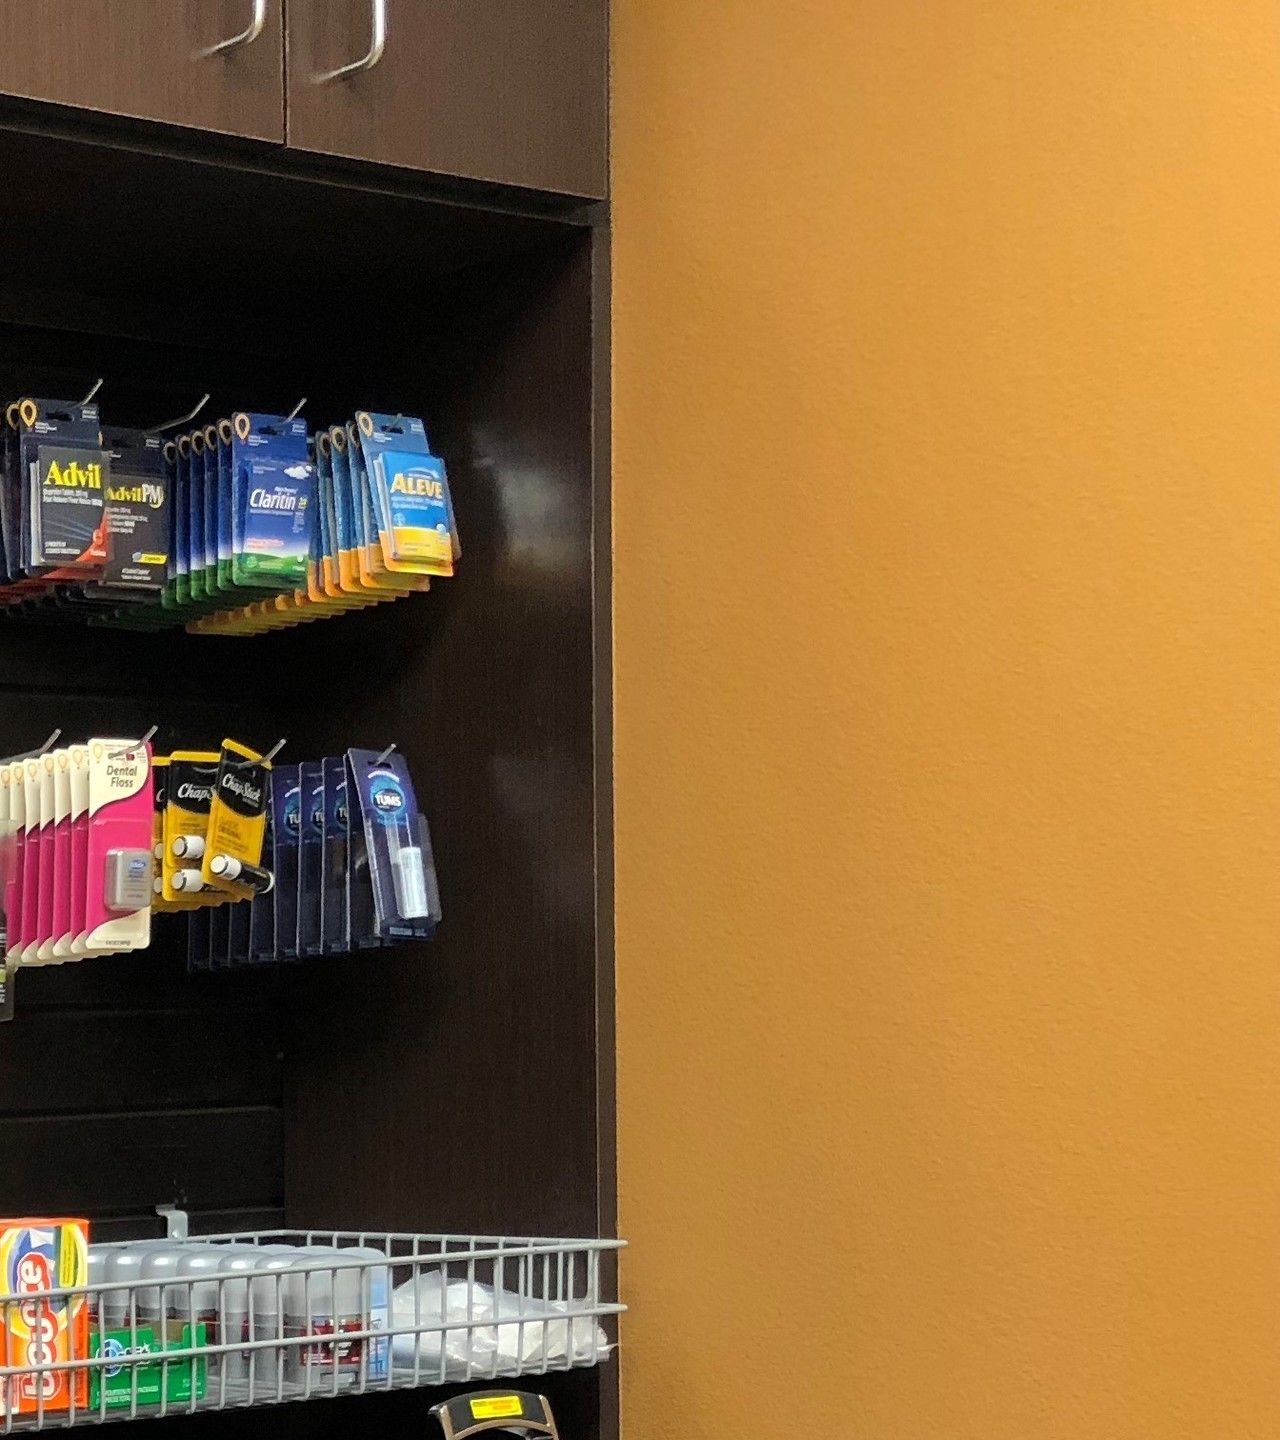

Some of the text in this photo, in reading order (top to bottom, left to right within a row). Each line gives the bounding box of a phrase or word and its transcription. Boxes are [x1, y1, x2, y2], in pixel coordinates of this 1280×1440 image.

[43, 459, 101, 489] Advil
[390, 473, 443, 499] ALEVE
[249, 489, 296, 510] Claritin
[106, 765, 137, 776] Dental
[110, 776, 134, 788] Floss
[222, 772, 263, 800] ChapStick
[374, 793, 402, 807] TUMS
